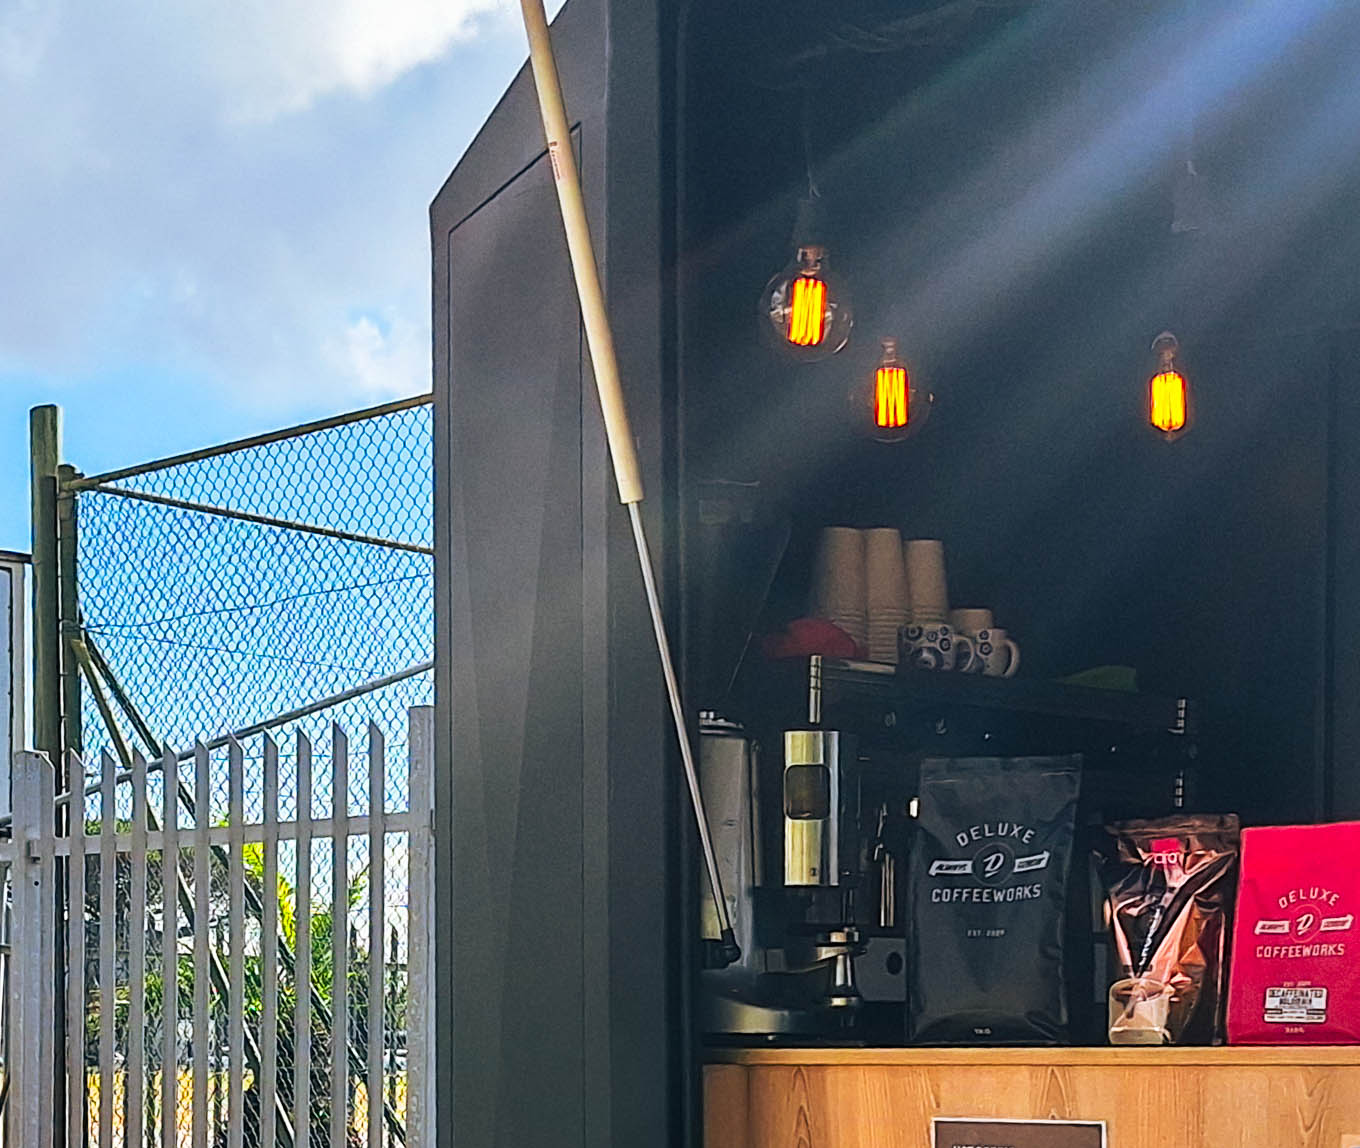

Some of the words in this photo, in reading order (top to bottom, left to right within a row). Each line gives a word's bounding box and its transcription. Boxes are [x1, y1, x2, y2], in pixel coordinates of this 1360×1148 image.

[956, 822, 1035, 847] DELUXE
[931, 884, 1041, 903] COFFEEWORKS
[1278, 887, 1340, 909] DELUXE
[1256, 943, 1345, 959] COFFEEWORKS
